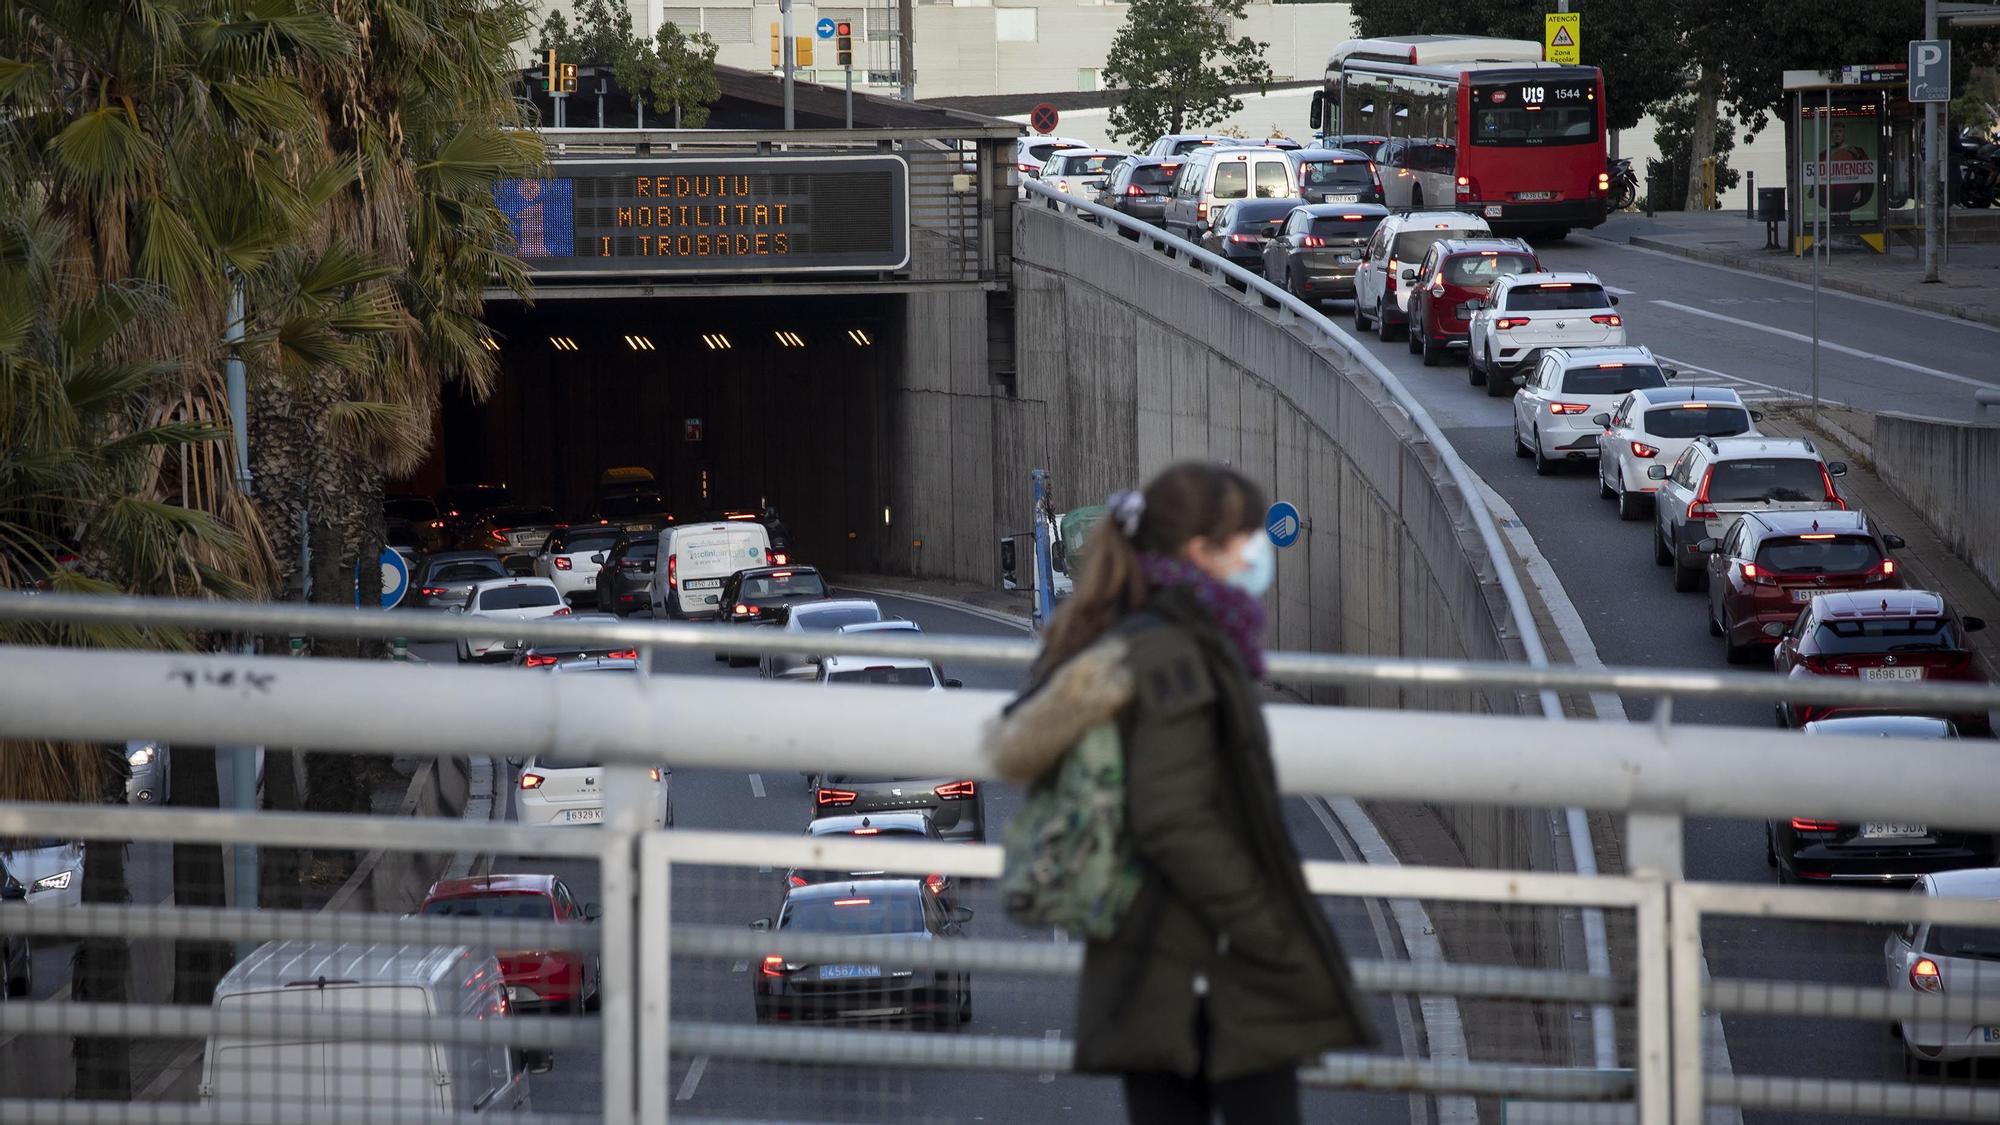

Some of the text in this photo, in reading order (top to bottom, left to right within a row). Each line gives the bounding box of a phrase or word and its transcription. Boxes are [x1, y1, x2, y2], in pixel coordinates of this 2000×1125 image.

[1918, 46, 1942, 77] P
[1555, 89, 1580, 99] 1544
[1820, 162, 1874, 176] DUMENGES
[637, 176, 750, 197] REDUIU
[618, 204, 786, 227] MOBILITAT
[602, 233, 787, 256] I TROBADES
[1869, 669, 1918, 680] 8696 LGY
[572, 811, 593, 820] 6329
[1869, 823, 1898, 833] 2815
